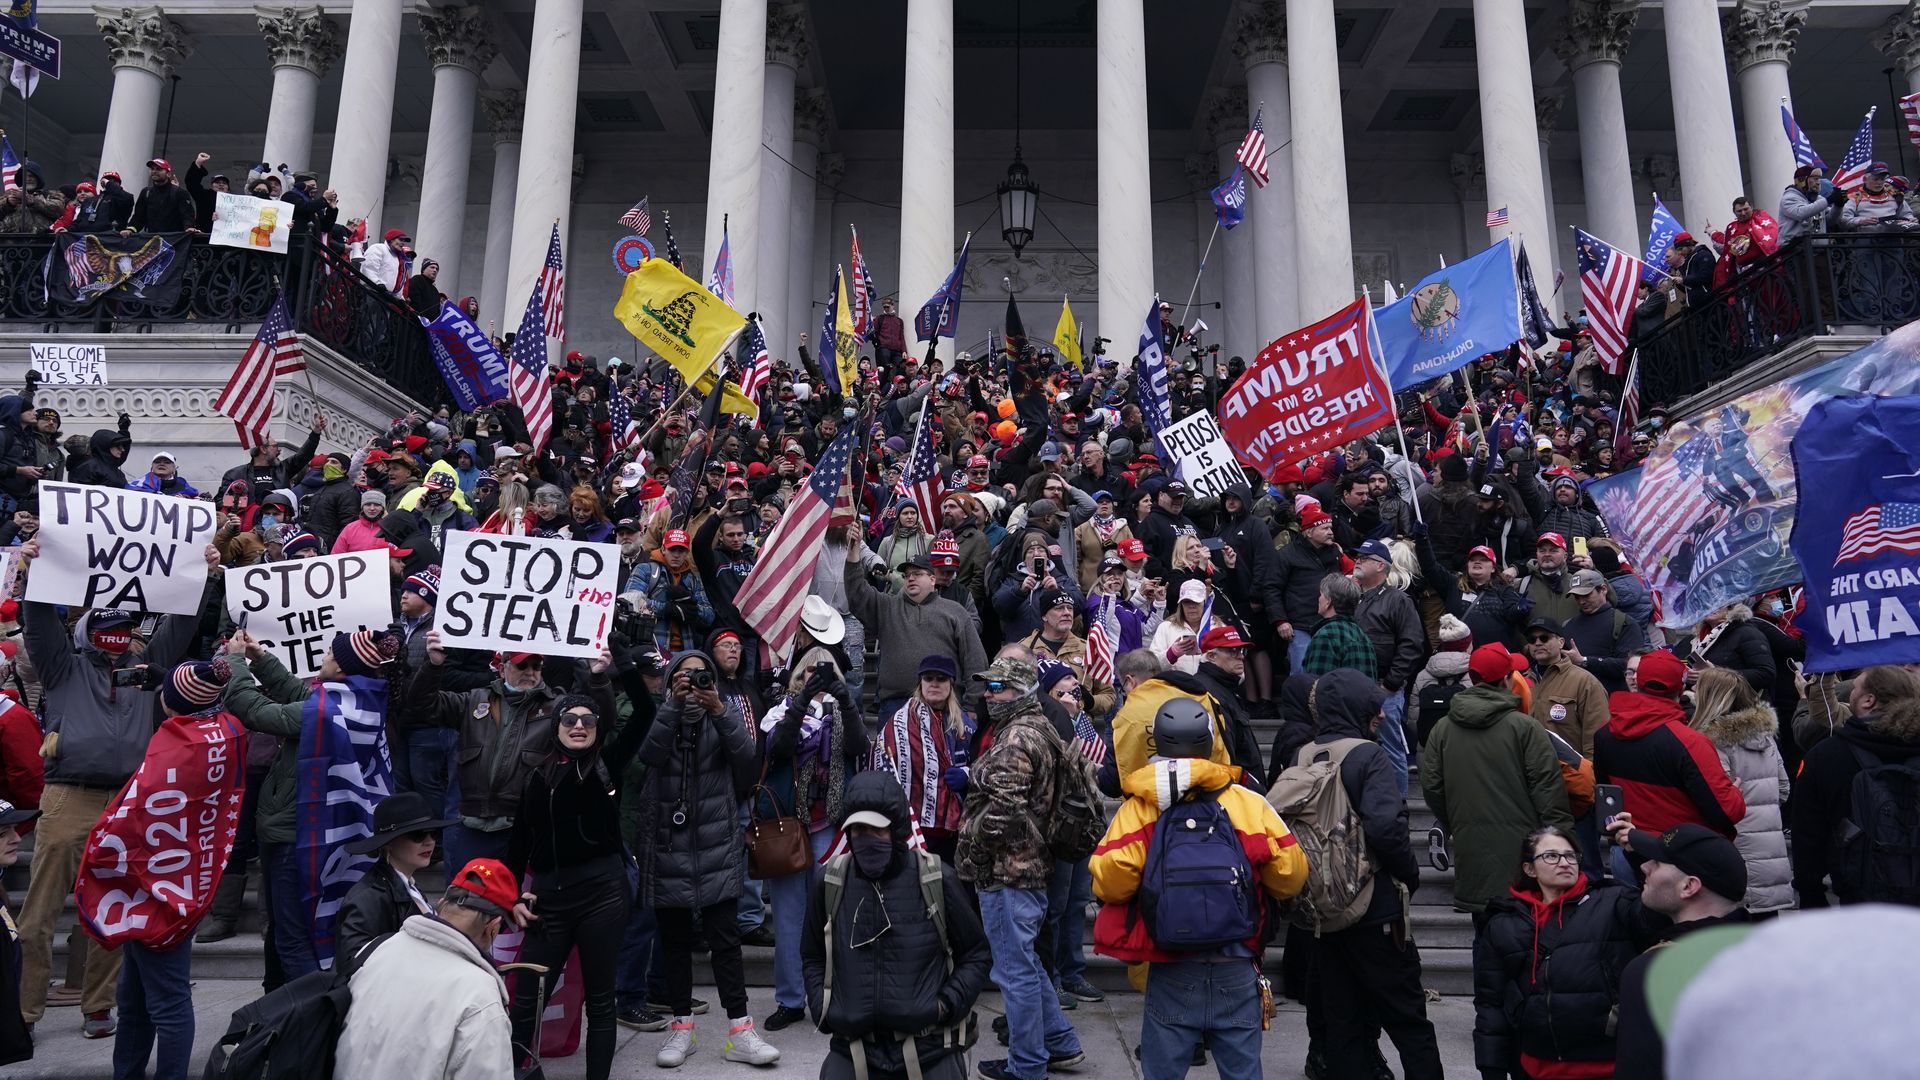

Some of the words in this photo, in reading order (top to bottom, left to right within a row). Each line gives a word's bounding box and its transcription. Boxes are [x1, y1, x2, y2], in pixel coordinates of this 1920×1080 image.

[0, 24, 56, 54] TRUMP
[4, 34, 51, 60] PENCE
[31, 346, 106, 362] WELCOME
[37, 360, 60, 372] TO
[68, 360, 99, 373] THE
[441, 306, 509, 389] TRUMP
[444, 359, 477, 406] BULLSHIT
[1163, 414, 1220, 460] PELOSI
[1192, 458, 1243, 497] SATAN
[1196, 450, 1213, 470] IS
[43, 485, 212, 544] TRUMP
[86, 533, 177, 577] WON
[460, 538, 604, 598] STOP
[83, 573, 148, 612] PA
[242, 556, 367, 612] STOP
[578, 587, 612, 607] the
[277, 605, 335, 636] THE
[442, 590, 607, 649] STEAL!
[926, 767, 938, 790] But
[921, 799, 936, 825] They
[145, 768, 193, 917] -2020-
